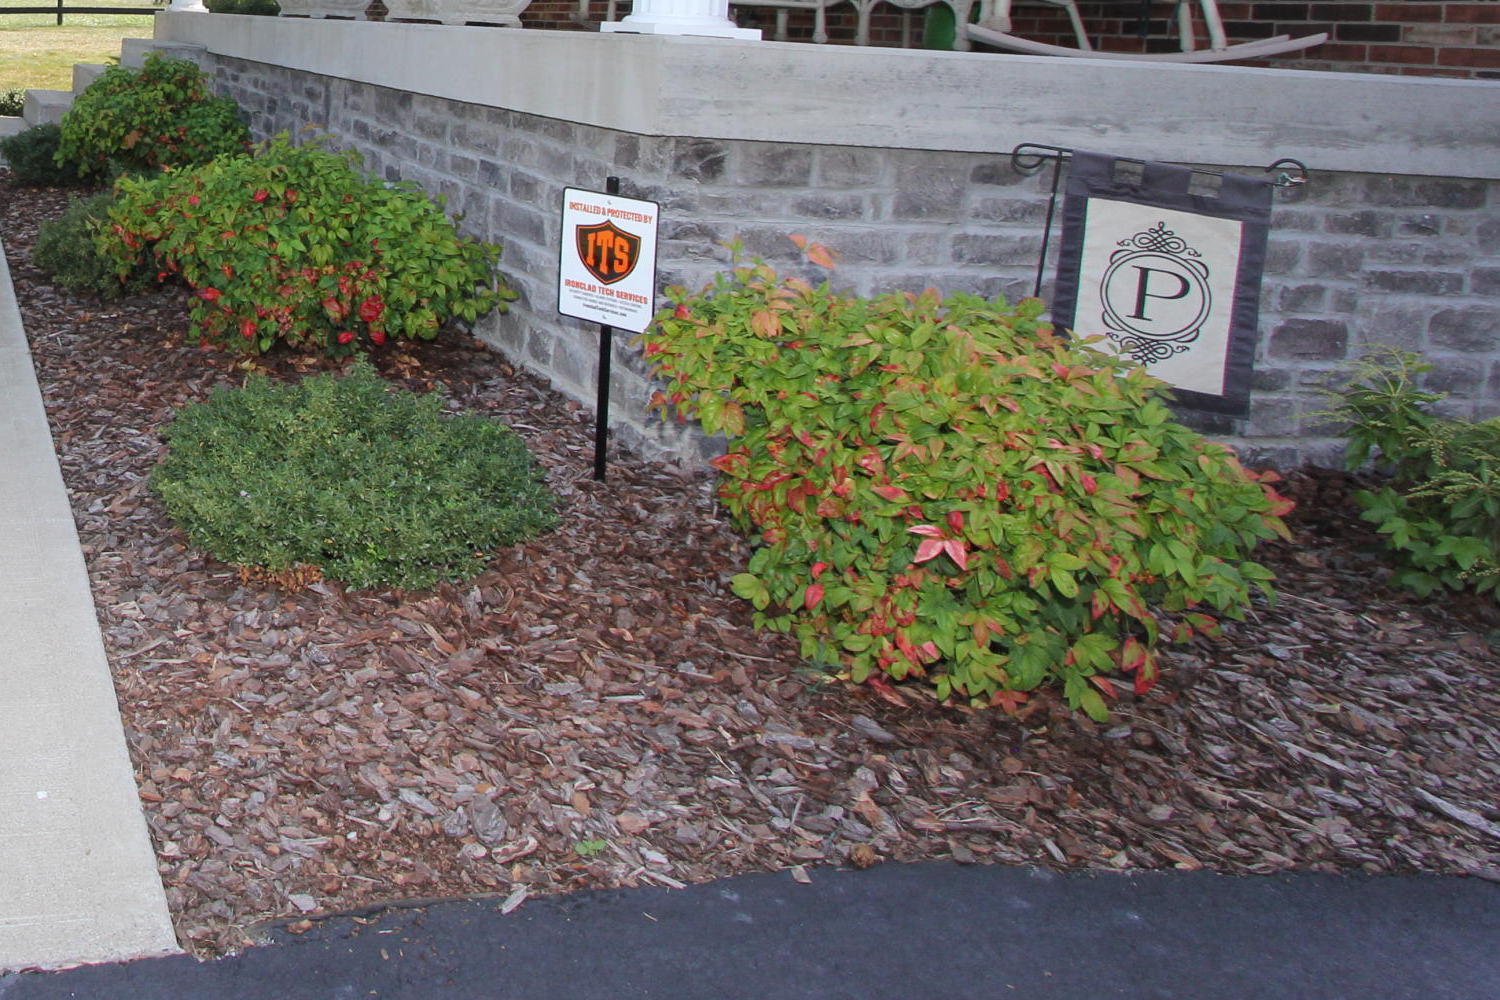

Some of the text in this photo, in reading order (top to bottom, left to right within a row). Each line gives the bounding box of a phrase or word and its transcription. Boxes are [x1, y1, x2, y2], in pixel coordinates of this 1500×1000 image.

[569, 201, 653, 224] INSTALLED & PROTECTED BY
[586, 229, 630, 275] ITS
[564, 278, 597, 293] IRONCLAD
[598, 286, 614, 297] TECH
[615, 290, 648, 304] SERVICES
[1125, 264, 1191, 322] P
